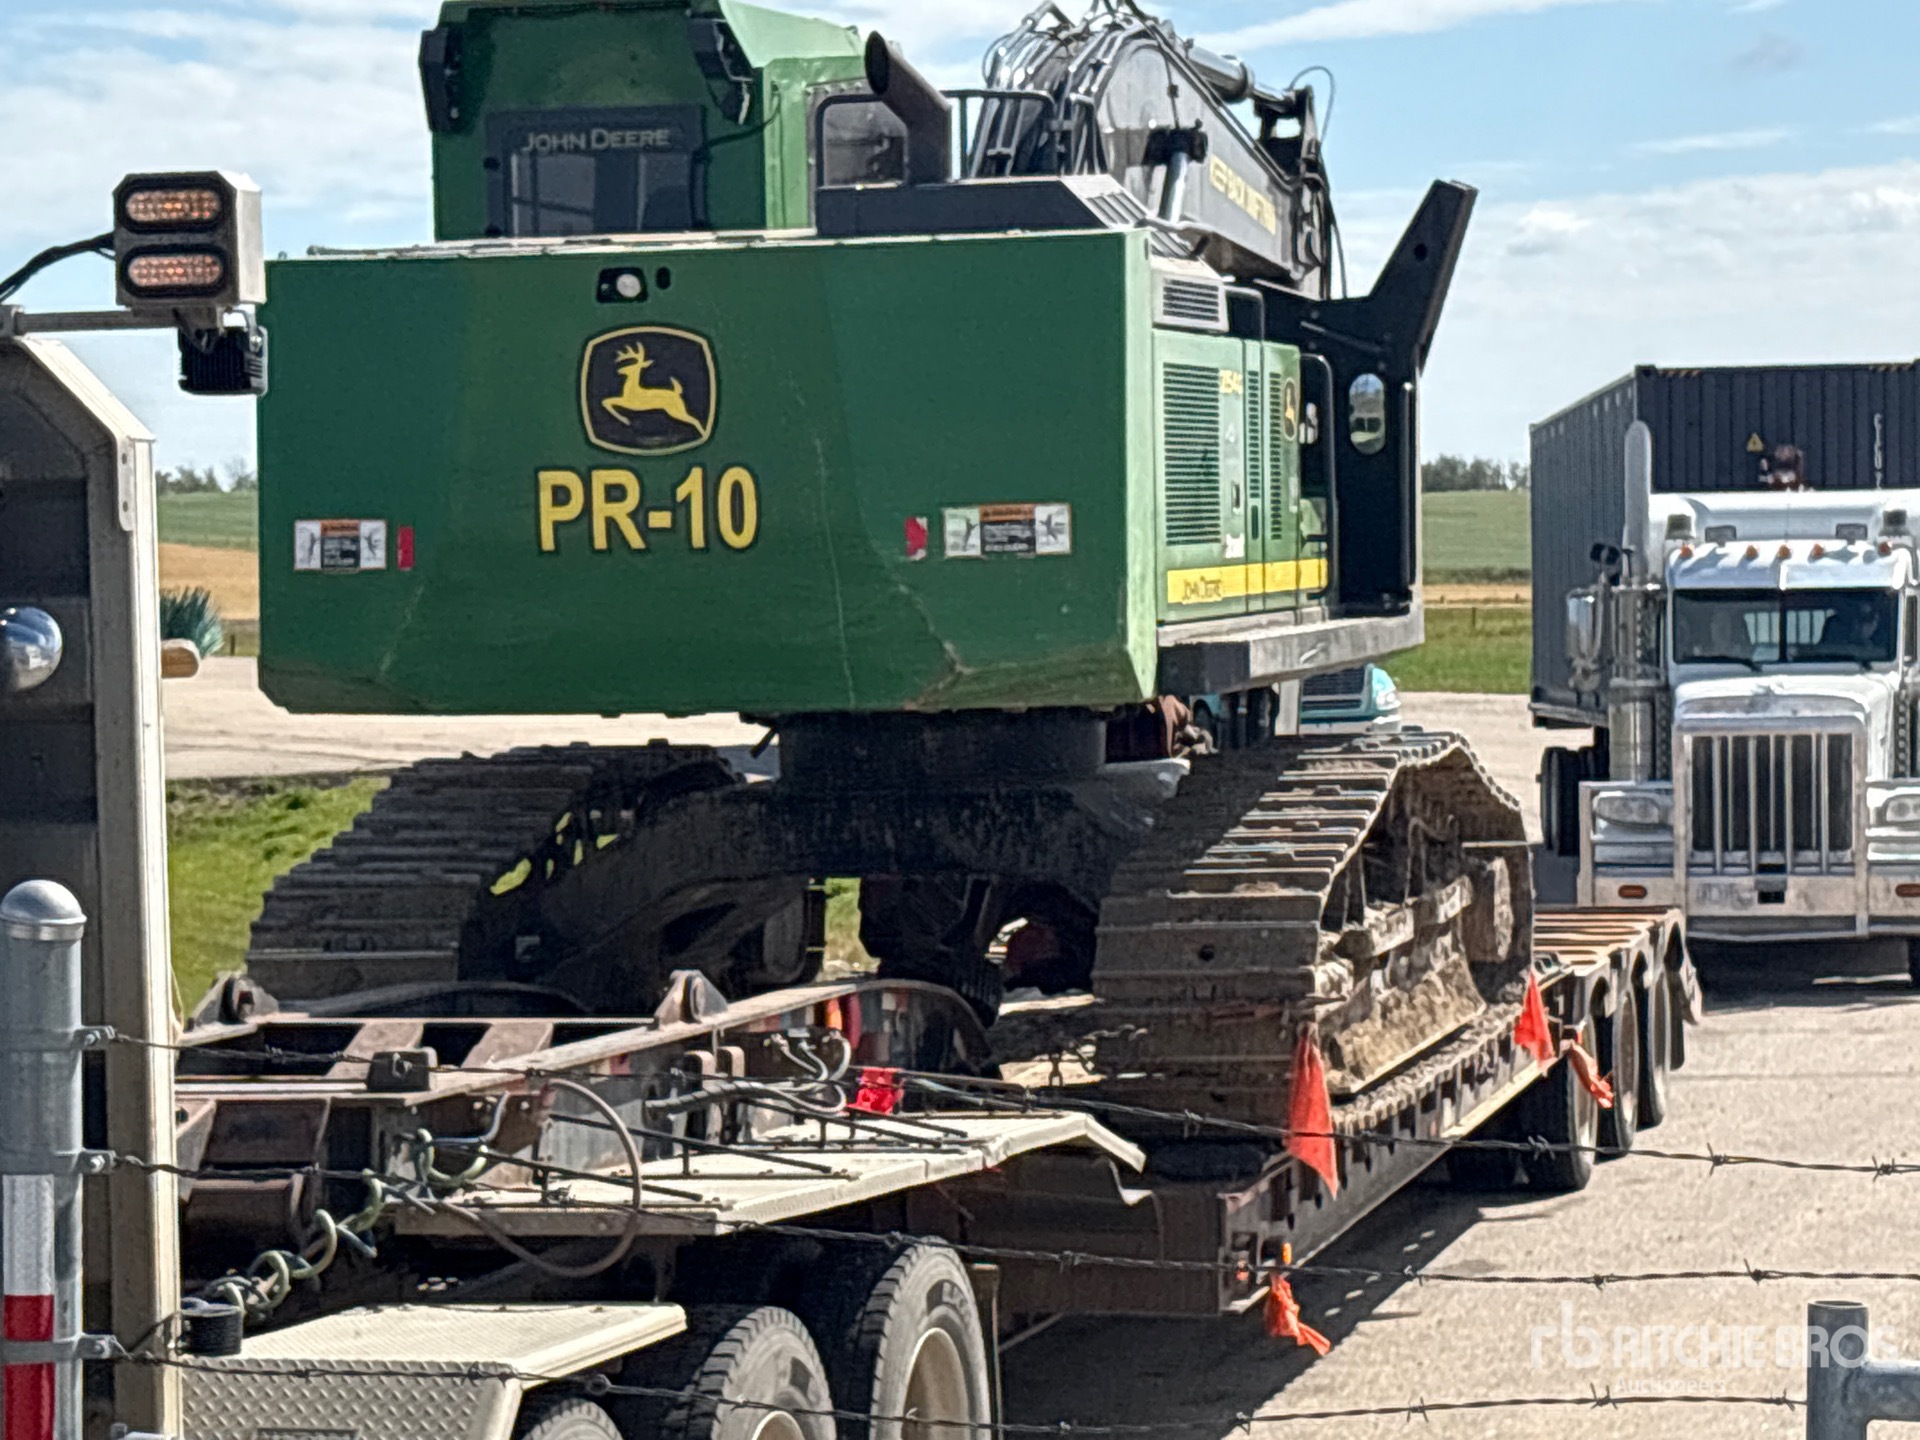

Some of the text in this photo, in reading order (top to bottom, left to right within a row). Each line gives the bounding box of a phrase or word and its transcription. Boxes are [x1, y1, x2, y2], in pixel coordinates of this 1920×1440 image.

[522, 129, 670, 153] JOHN DEERE
[537, 466, 758, 551] PR-10
